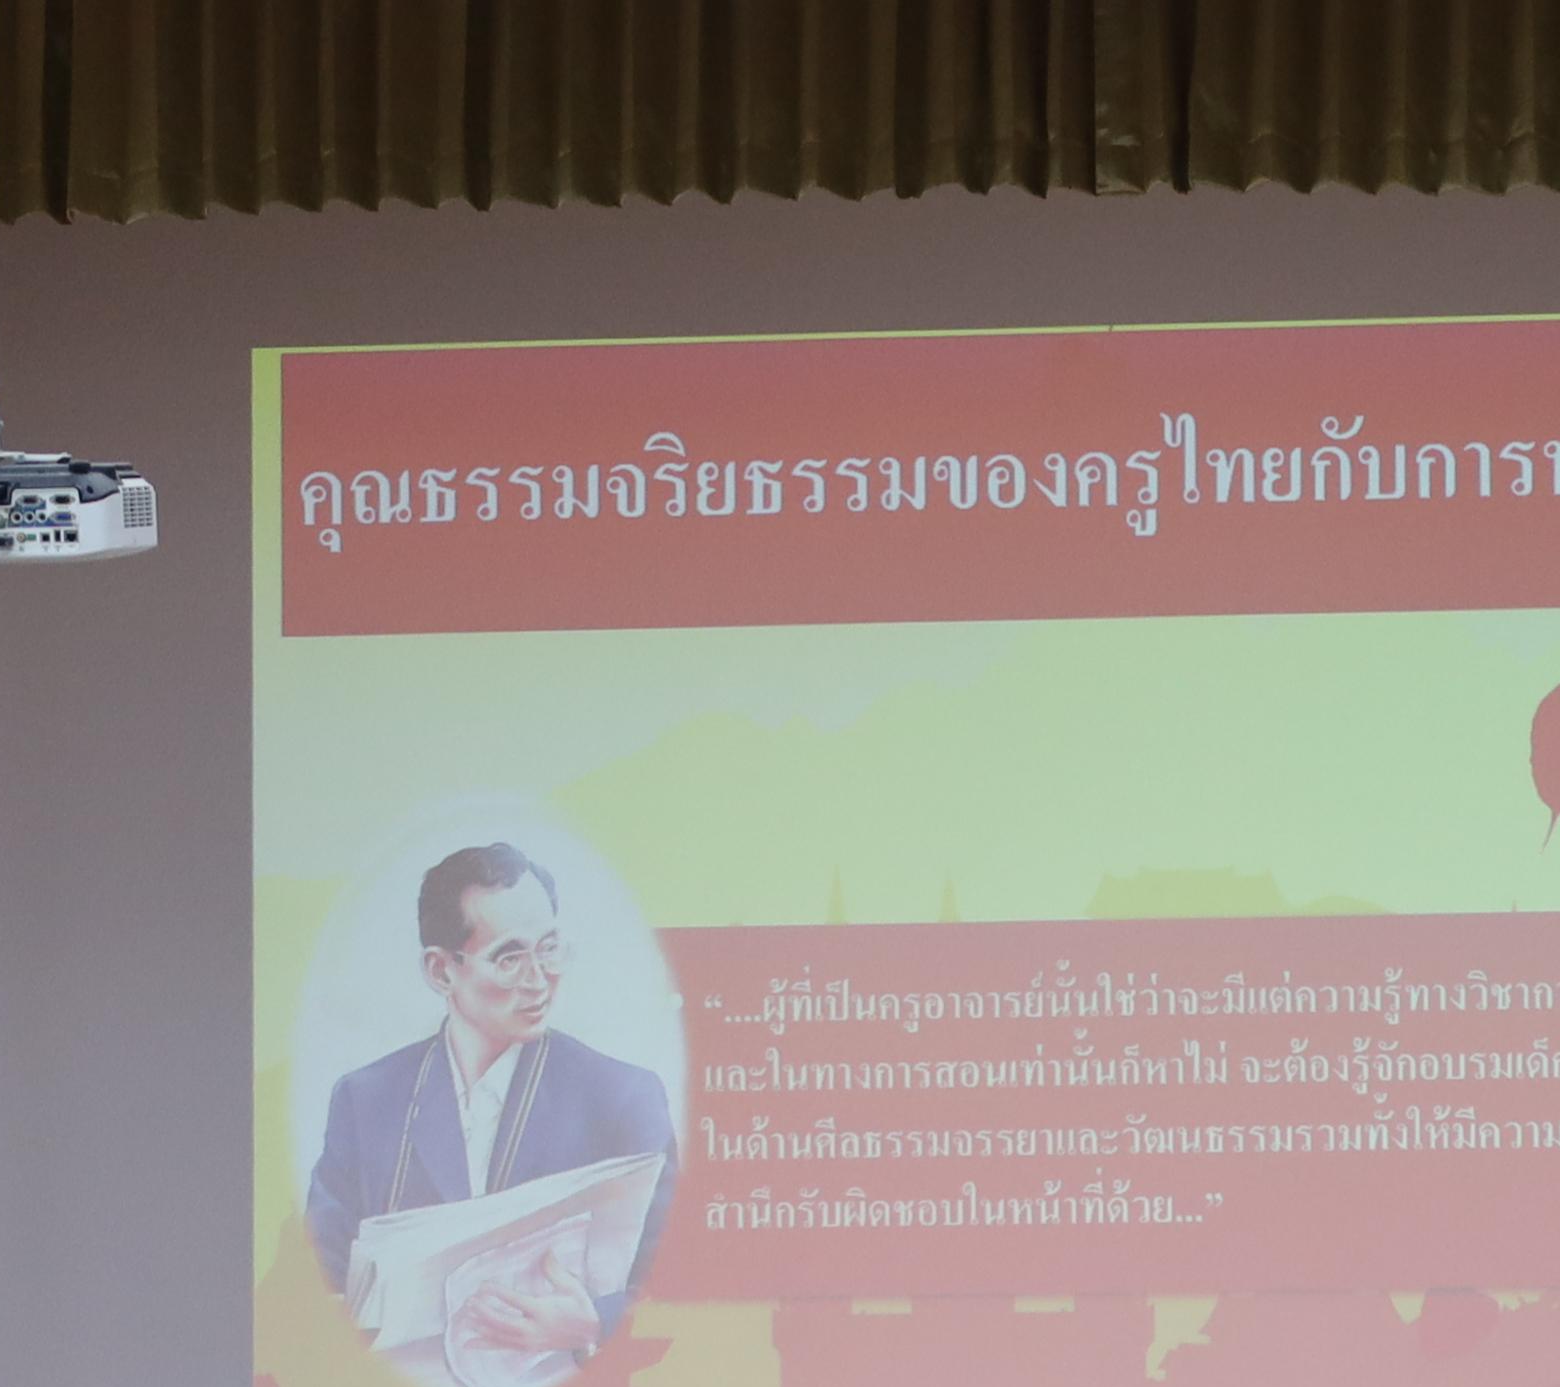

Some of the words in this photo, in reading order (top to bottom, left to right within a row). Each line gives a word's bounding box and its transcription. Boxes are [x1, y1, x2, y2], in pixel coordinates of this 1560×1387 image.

[702, 1028, 1229, 1093] และในทางการสอนเท่านั้นก็หาไม่
